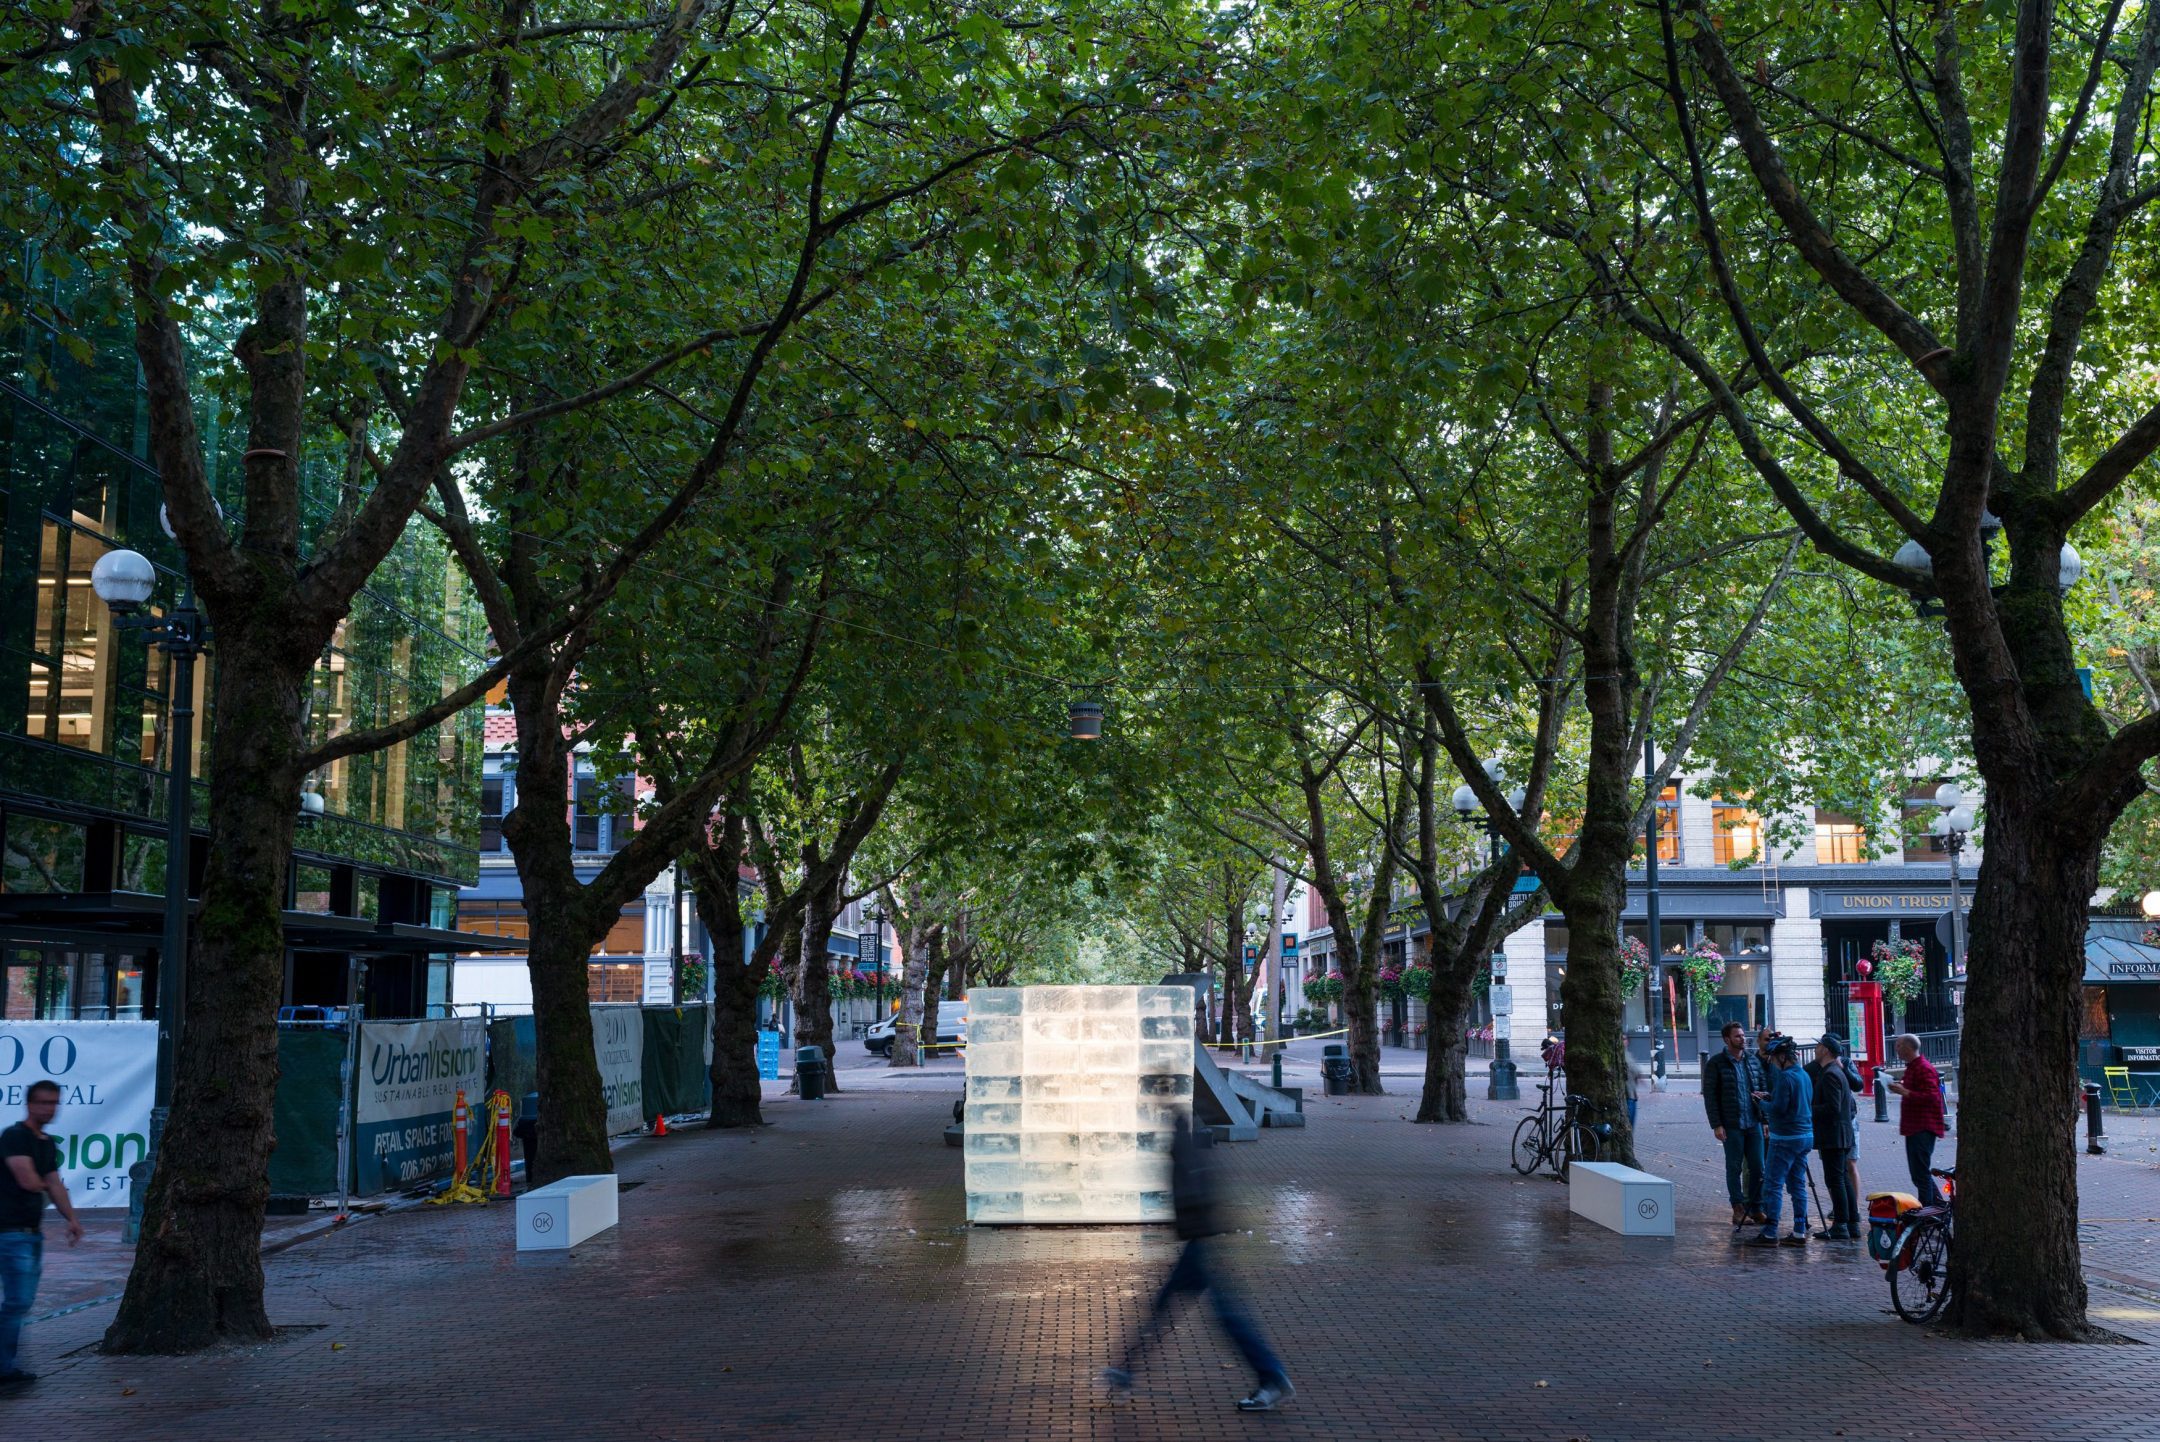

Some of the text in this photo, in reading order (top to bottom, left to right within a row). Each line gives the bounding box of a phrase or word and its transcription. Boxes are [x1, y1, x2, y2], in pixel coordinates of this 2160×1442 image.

[1843, 895, 1892, 908] UNION
[1898, 895, 1952, 908] TRUST
[860, 935, 868, 962] SQUARE
[867, 935, 875, 962] PIONEER
[432, 1082, 452, 1096] REAL
[404, 1124, 437, 1150] SPACE
[1640, 1203, 1656, 1214] OK
[535, 1217, 551, 1228] OK
